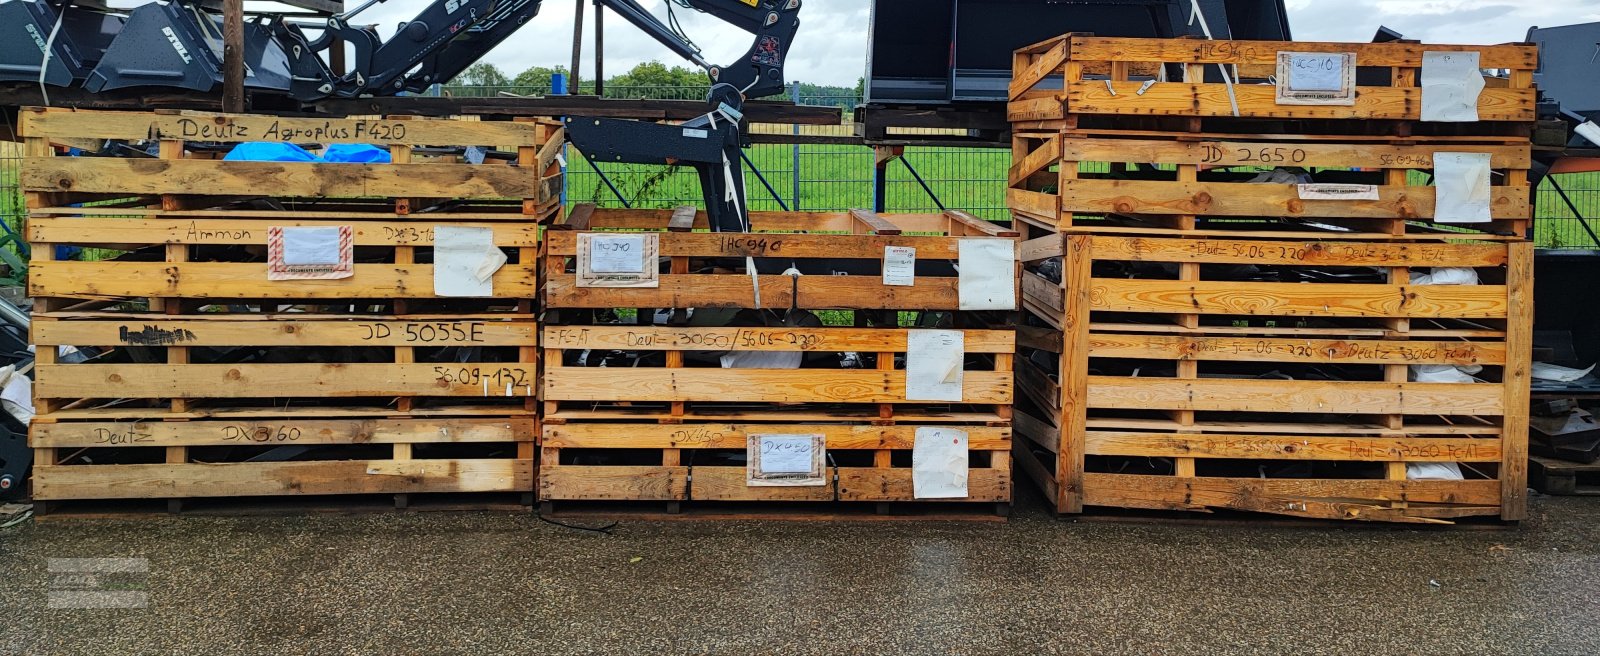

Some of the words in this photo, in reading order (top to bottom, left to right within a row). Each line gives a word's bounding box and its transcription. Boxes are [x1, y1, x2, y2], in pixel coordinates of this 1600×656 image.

[161, 26, 193, 64] STOLL
[177, 118, 248, 138] Deutz
[263, 121, 349, 140] Agroplus
[1201, 145, 1223, 163] JD
[1237, 147, 1306, 163] 2650
[187, 221, 251, 242] Ammon
[720, 236, 744, 252] IHC
[746, 237, 782, 251] 940
[358, 323, 391, 340] JD
[406, 323, 485, 342] 5055E
[1347, 342, 1391, 359] Deutz
[94, 427, 155, 445] Deutz
